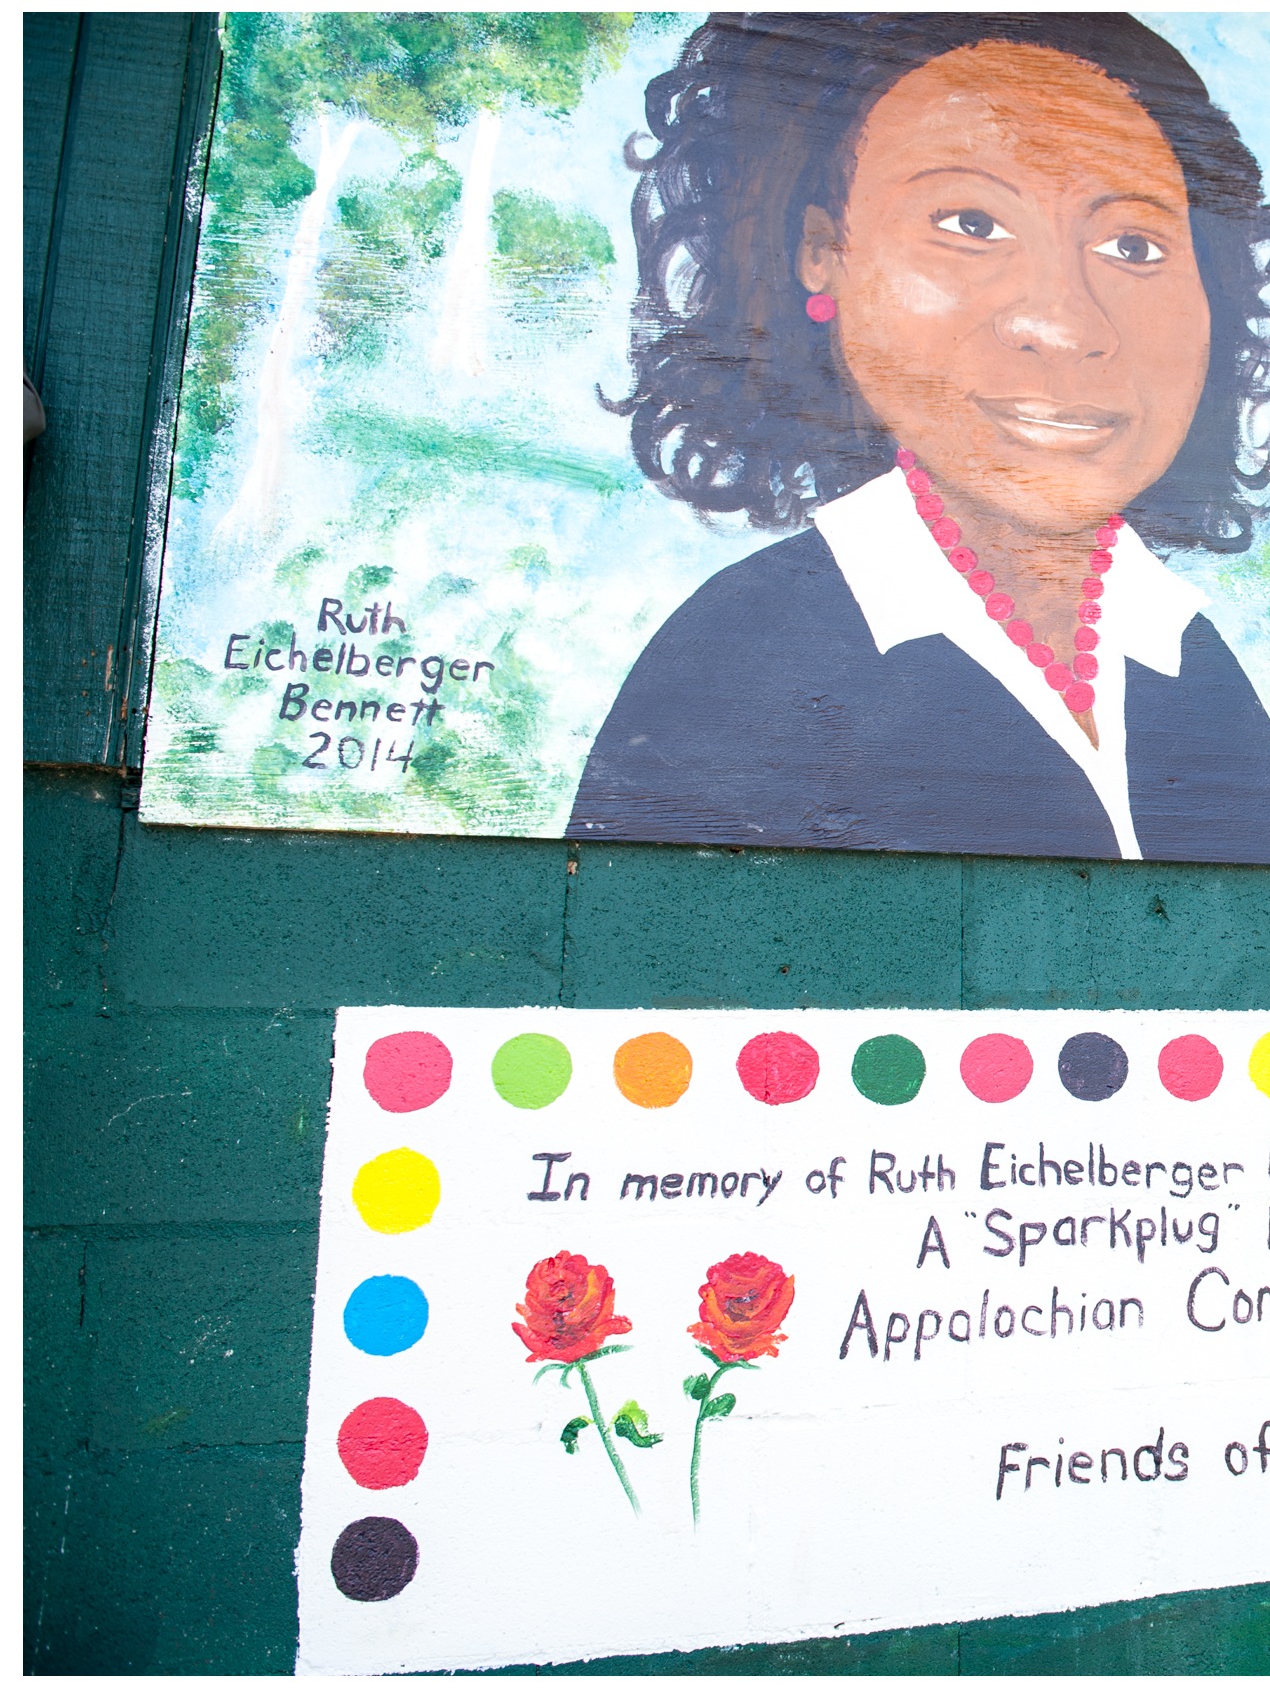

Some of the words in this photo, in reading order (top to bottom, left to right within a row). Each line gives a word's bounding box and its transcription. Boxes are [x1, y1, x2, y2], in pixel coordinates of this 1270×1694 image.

[317, 597, 407, 636] Ruth
[222, 631, 496, 695] Eichelberger
[278, 680, 447, 727] Bennett
[300, 730, 415, 774] 2014
[528, 1152, 589, 1201] In
[620, 1169, 782, 1206] memory
[806, 1157, 846, 1198] of
[870, 1149, 955, 1194] Ruth
[980, 1142, 1244, 1198] Eichelberger
[917, 1216, 950, 1268] A
[965, 1204, 1240, 1270] "Sparkplug"
[996, 1427, 1189, 1500] Friends
